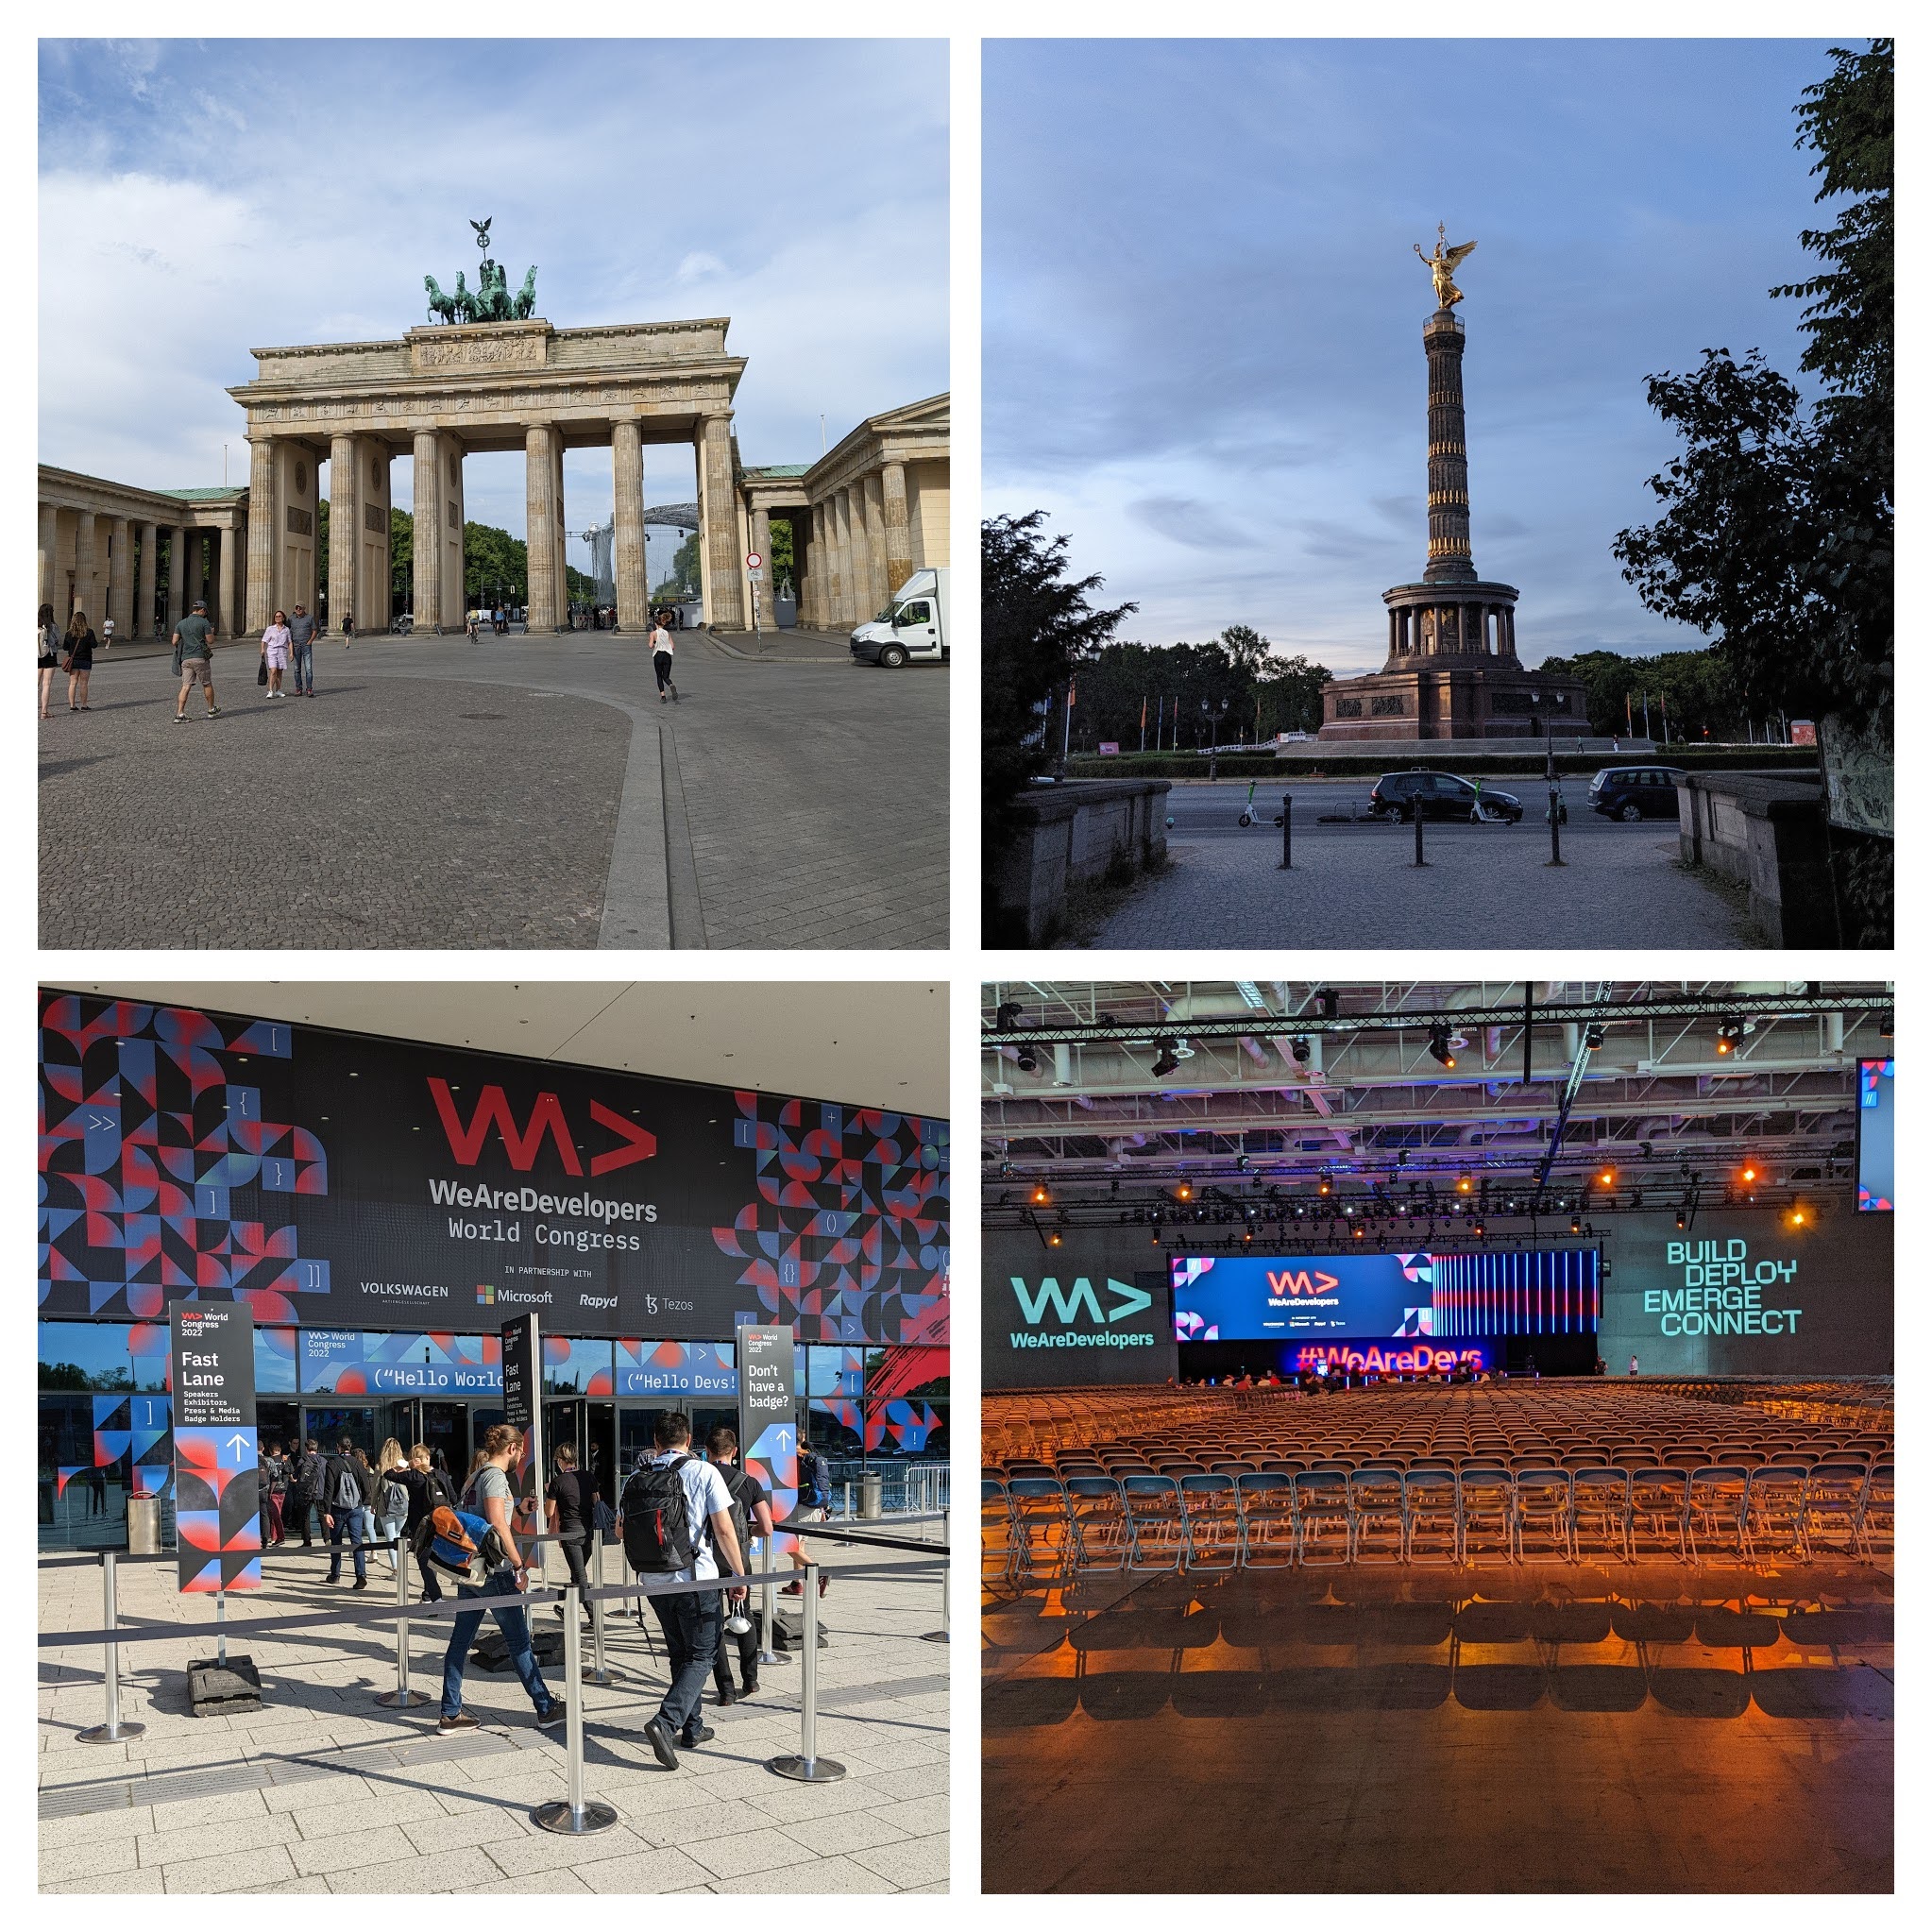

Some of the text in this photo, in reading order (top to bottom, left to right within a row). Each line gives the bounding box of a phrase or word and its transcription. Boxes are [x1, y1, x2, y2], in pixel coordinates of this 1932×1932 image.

[429, 1179, 657, 1225] WeAreDevelopers
[449, 1217, 640, 1251] World Congress
[1668, 1239, 1746, 1264] BUILD
[504, 1265, 592, 1279] IN PARTNERSHIP WITH
[1686, 1260, 1797, 1287] DEPLOY
[361, 1282, 449, 1297] VOLKSWAGEN
[498, 1289, 553, 1304] Microsoft
[579, 1294, 619, 1309] Rapyd
[662, 1297, 694, 1311] Tezos
[1644, 1285, 1762, 1313] EMERGE
[181, 1320, 219, 1330] Congress
[1660, 1310, 1803, 1336] CONNECT
[331, 1332, 355, 1341] World
[1010, 1330, 1154, 1349] WeAreDevelopers
[308, 1340, 346, 1349] Congress
[181, 1351, 219, 1366] Fast
[308, 1349, 330, 1358] 2022
[1296, 1345, 1483, 1372] #WeAreDevs
[505, 1363, 518, 1377] Fast
[748, 1364, 778, 1377] Don’t
[182, 1371, 225, 1386] Lane
[506, 1381, 521, 1393] Lane
[749, 1381, 785, 1392] have a
[749, 1395, 788, 1410] badge?
